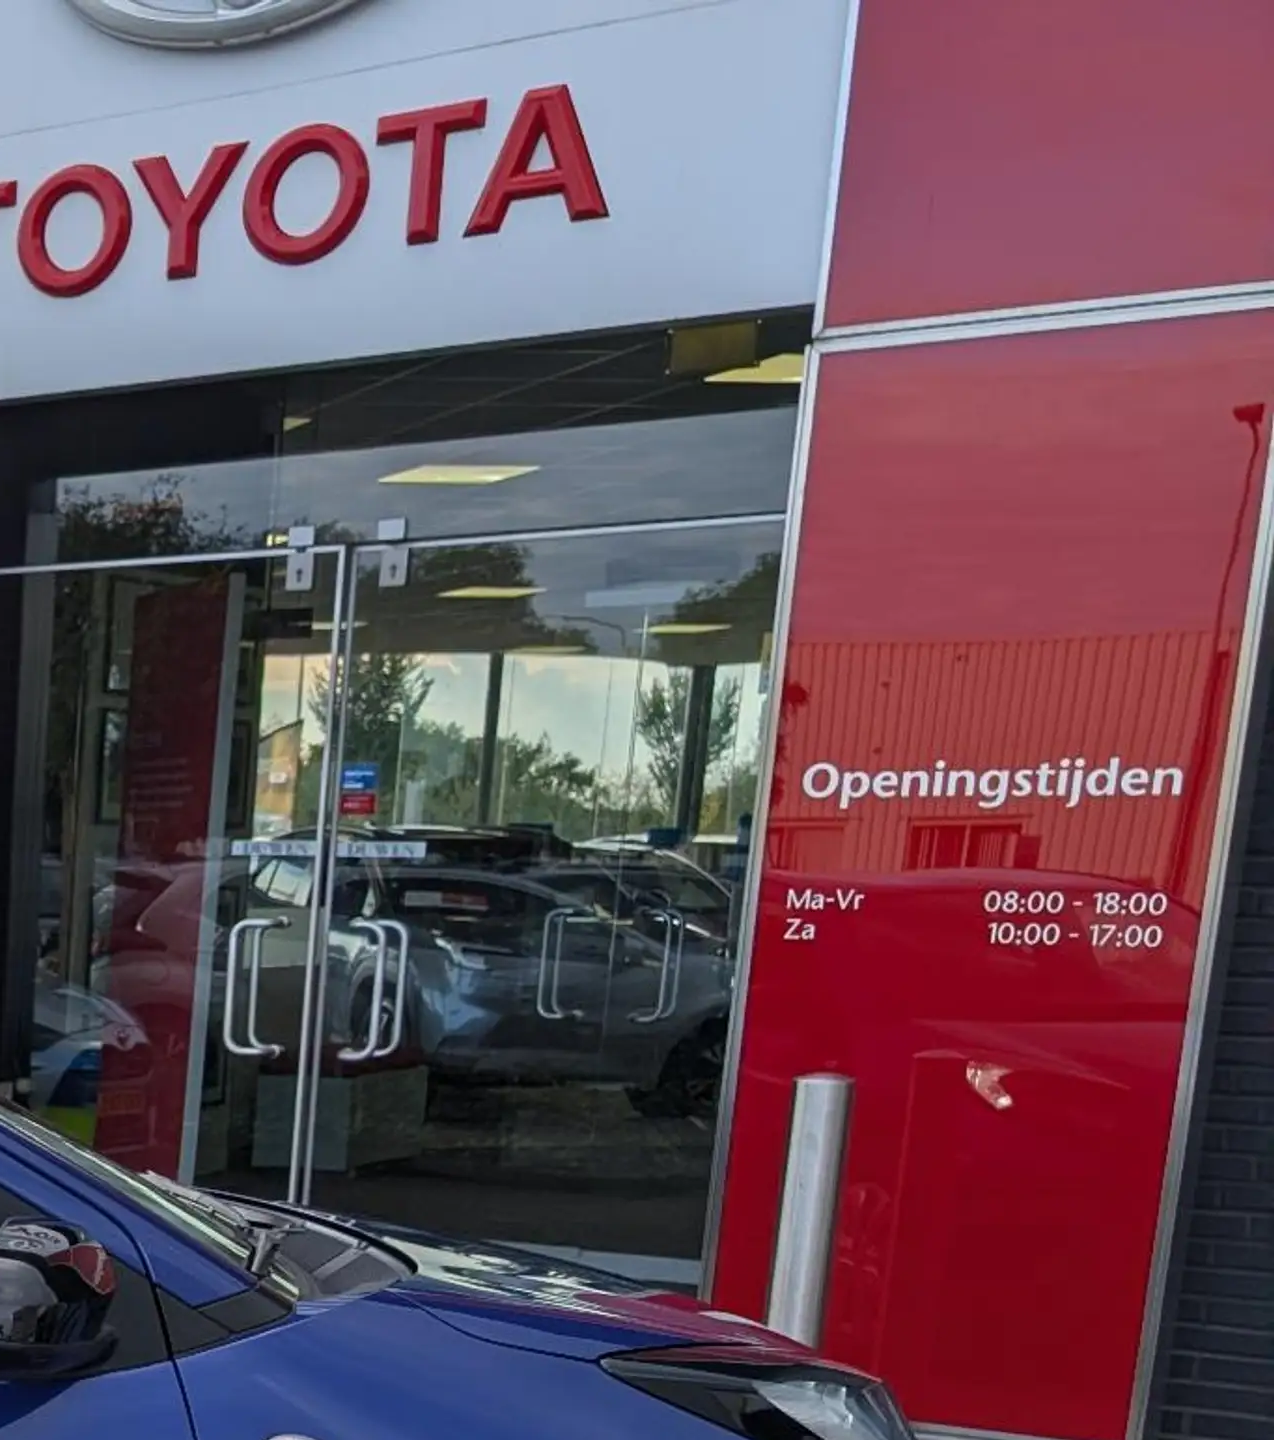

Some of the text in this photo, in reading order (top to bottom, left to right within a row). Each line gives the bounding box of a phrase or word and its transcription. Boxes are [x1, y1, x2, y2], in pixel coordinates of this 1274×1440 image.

[802, 757, 1184, 809] Openingstijden
[785, 888, 865, 911] Ma-Vr
[983, 890, 1065, 914] 08:00
[1093, 891, 1169, 916] 18:00
[783, 918, 816, 941] Za
[988, 922, 1061, 946] 10:00
[1089, 924, 1164, 948] 17:00
